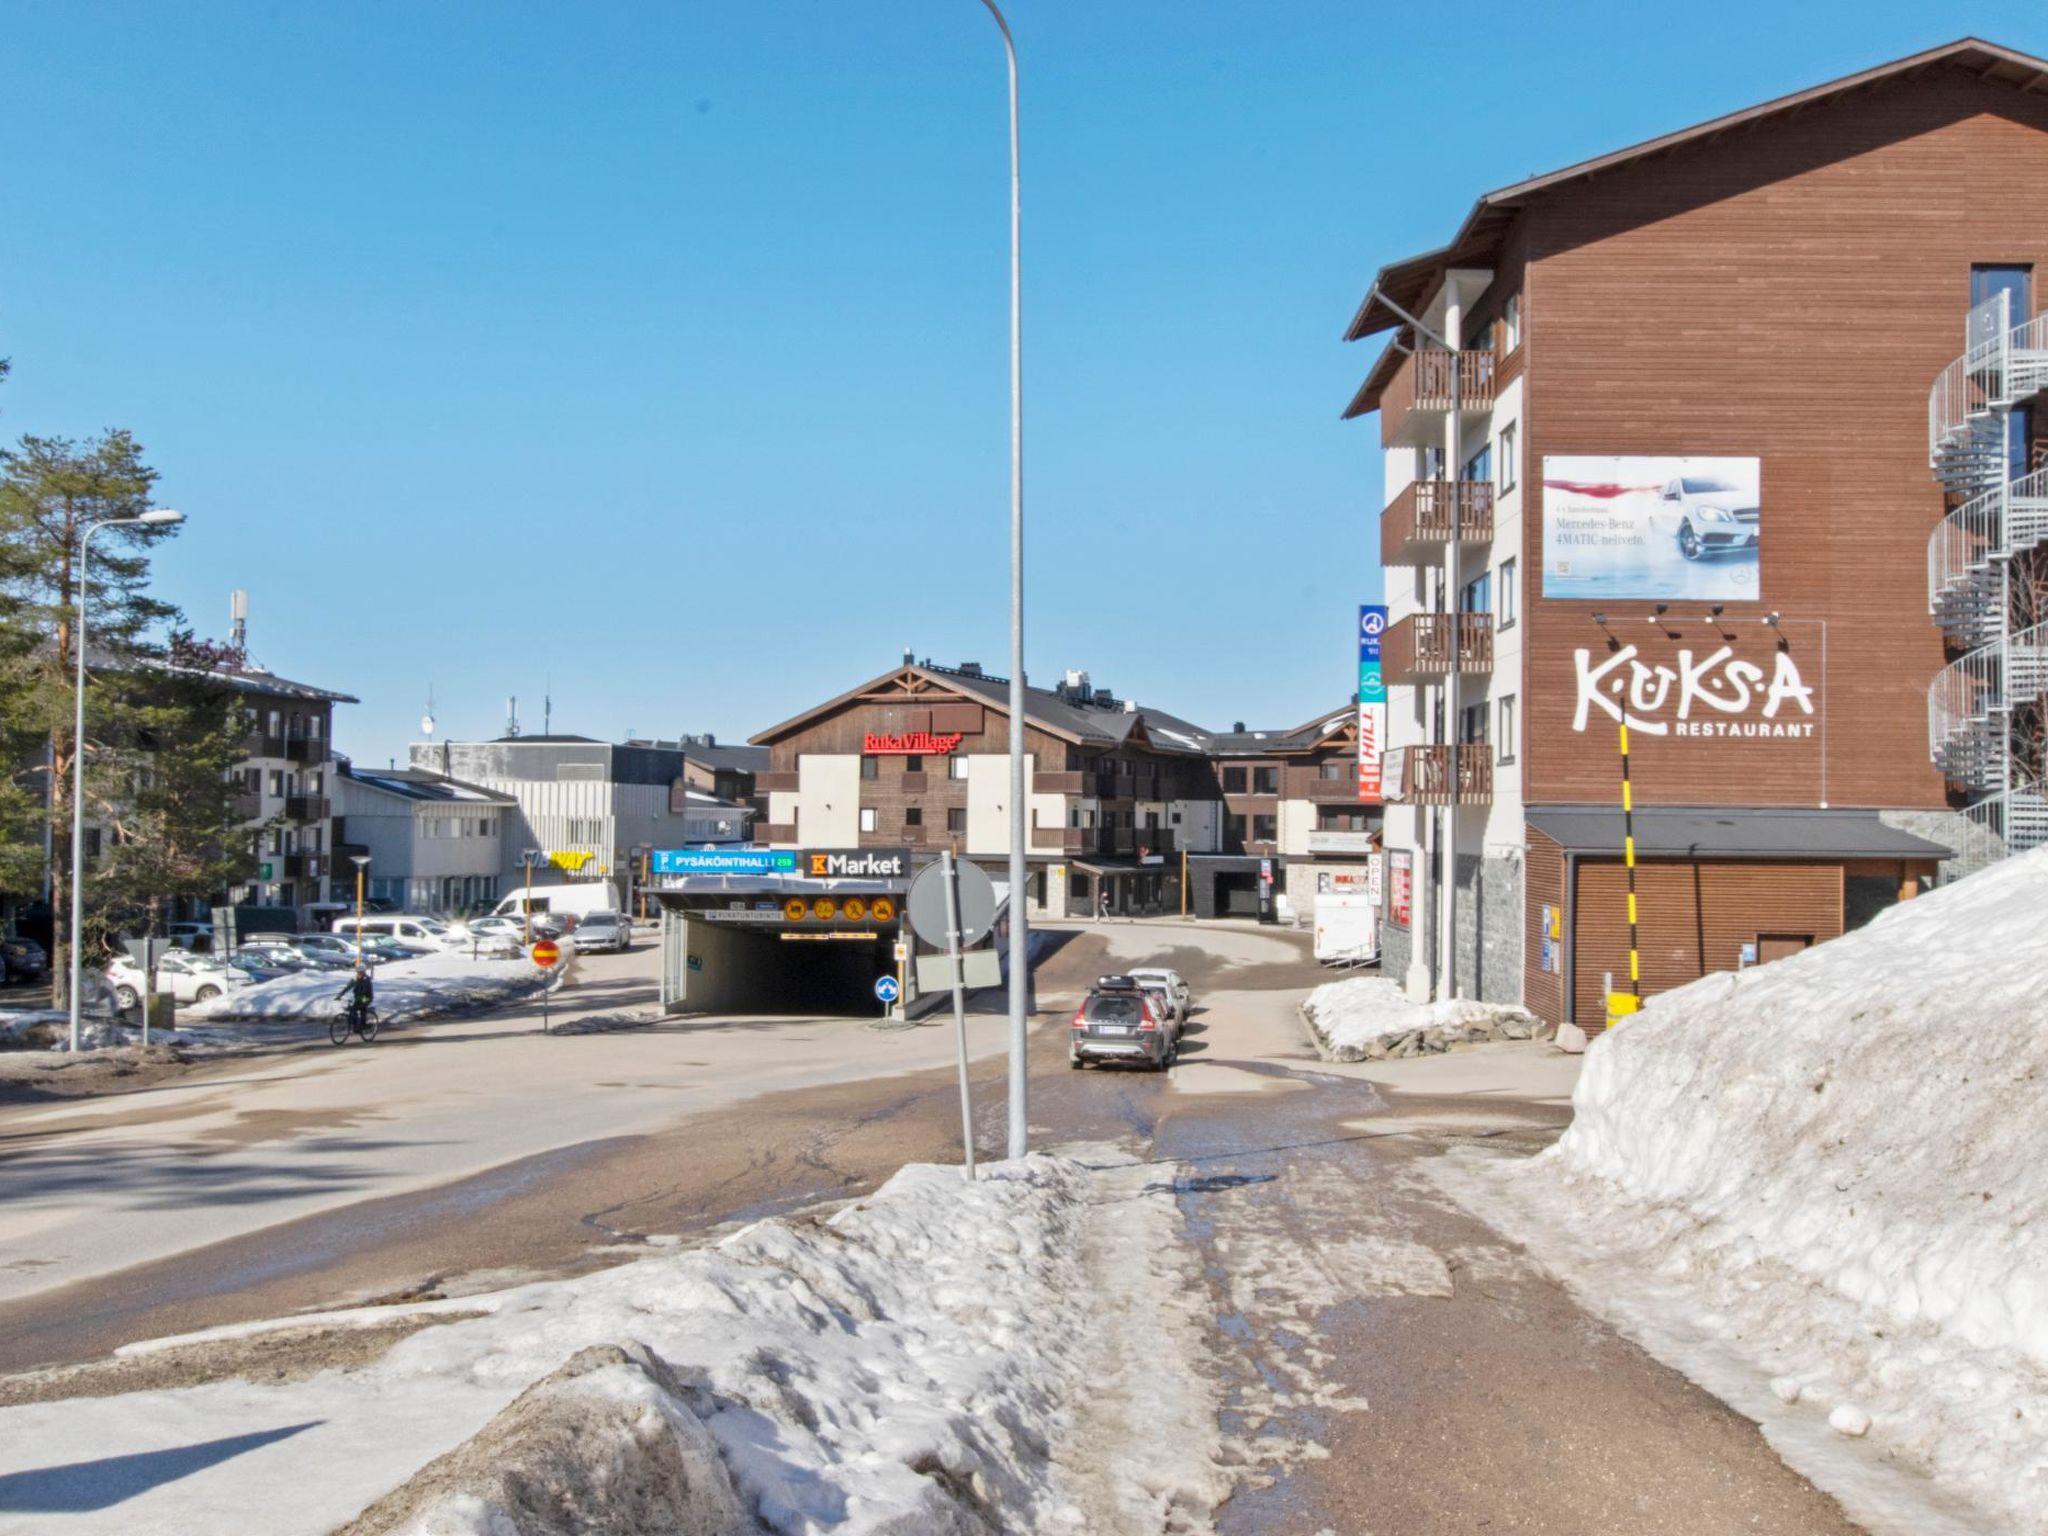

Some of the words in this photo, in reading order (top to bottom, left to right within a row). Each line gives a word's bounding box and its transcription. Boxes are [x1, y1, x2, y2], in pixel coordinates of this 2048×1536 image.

[1572, 645, 1814, 736] KUKSA
[1675, 722, 1813, 738] RESTAURANT
[676, 856, 775, 867] PYSÄKÖINTIHALLI
